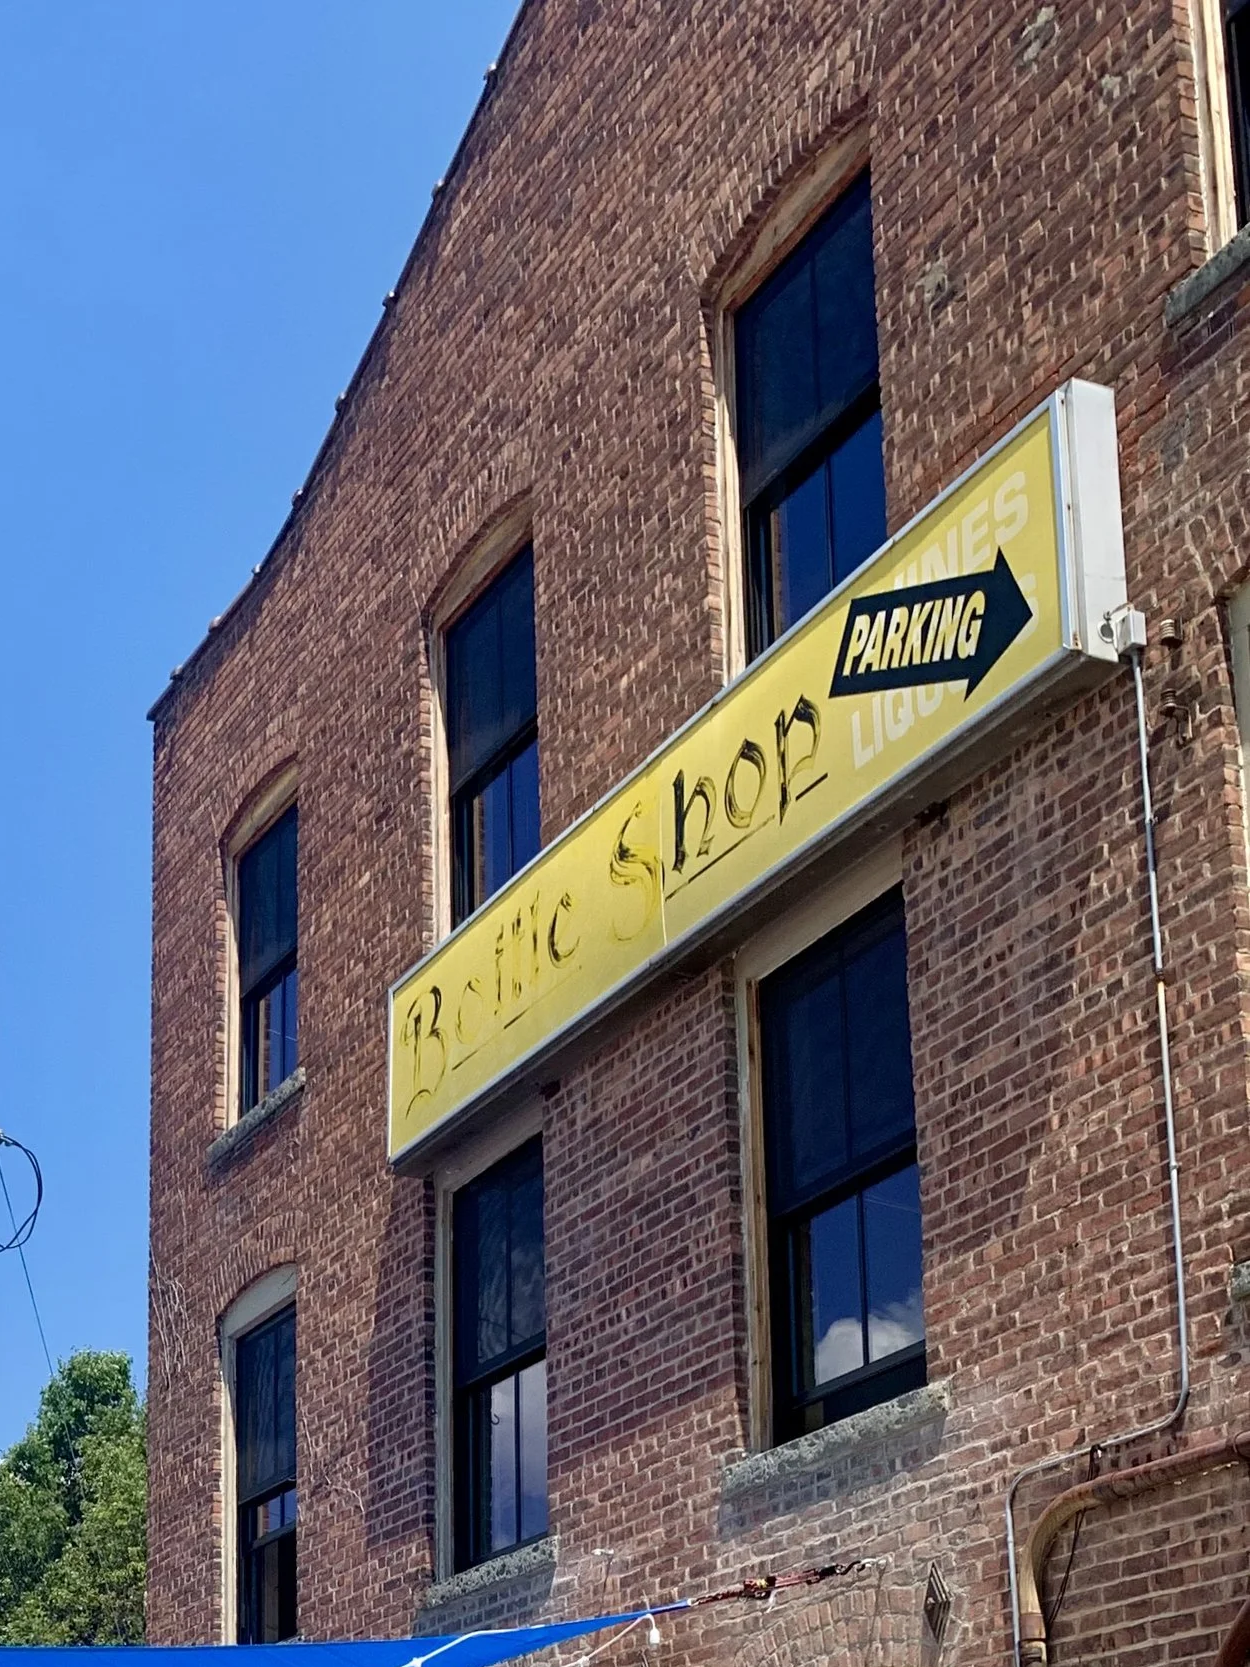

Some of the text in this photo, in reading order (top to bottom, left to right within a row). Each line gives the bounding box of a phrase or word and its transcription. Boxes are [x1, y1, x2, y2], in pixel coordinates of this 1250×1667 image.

[893, 470, 1029, 590] NES
[842, 589, 986, 677] PARKING
[851, 572, 1040, 770] LIQUS
[402, 694, 821, 1120] Bottle Shop
